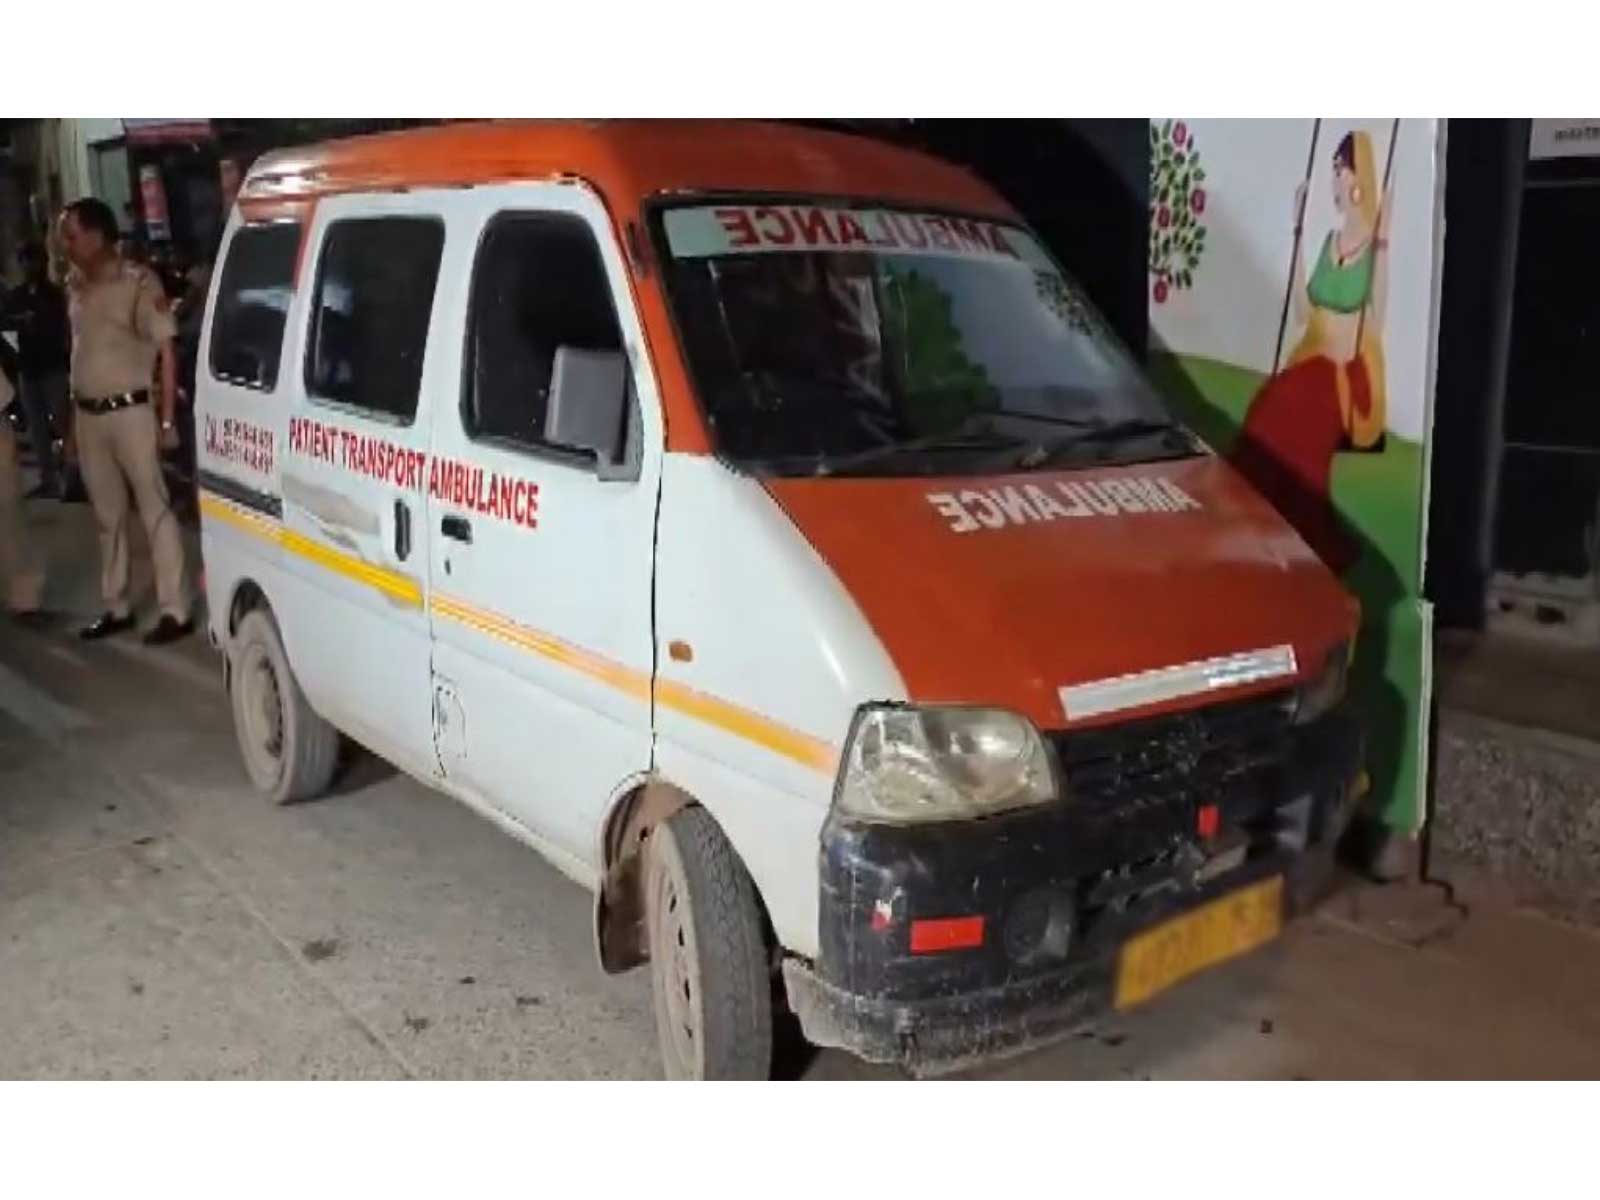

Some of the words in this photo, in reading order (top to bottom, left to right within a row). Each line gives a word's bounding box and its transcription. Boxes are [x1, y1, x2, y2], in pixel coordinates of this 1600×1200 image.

[289, 417, 338, 466] PATIENT
[342, 430, 426, 492] TRANSPORT
[428, 455, 539, 529] AMBULANCE
